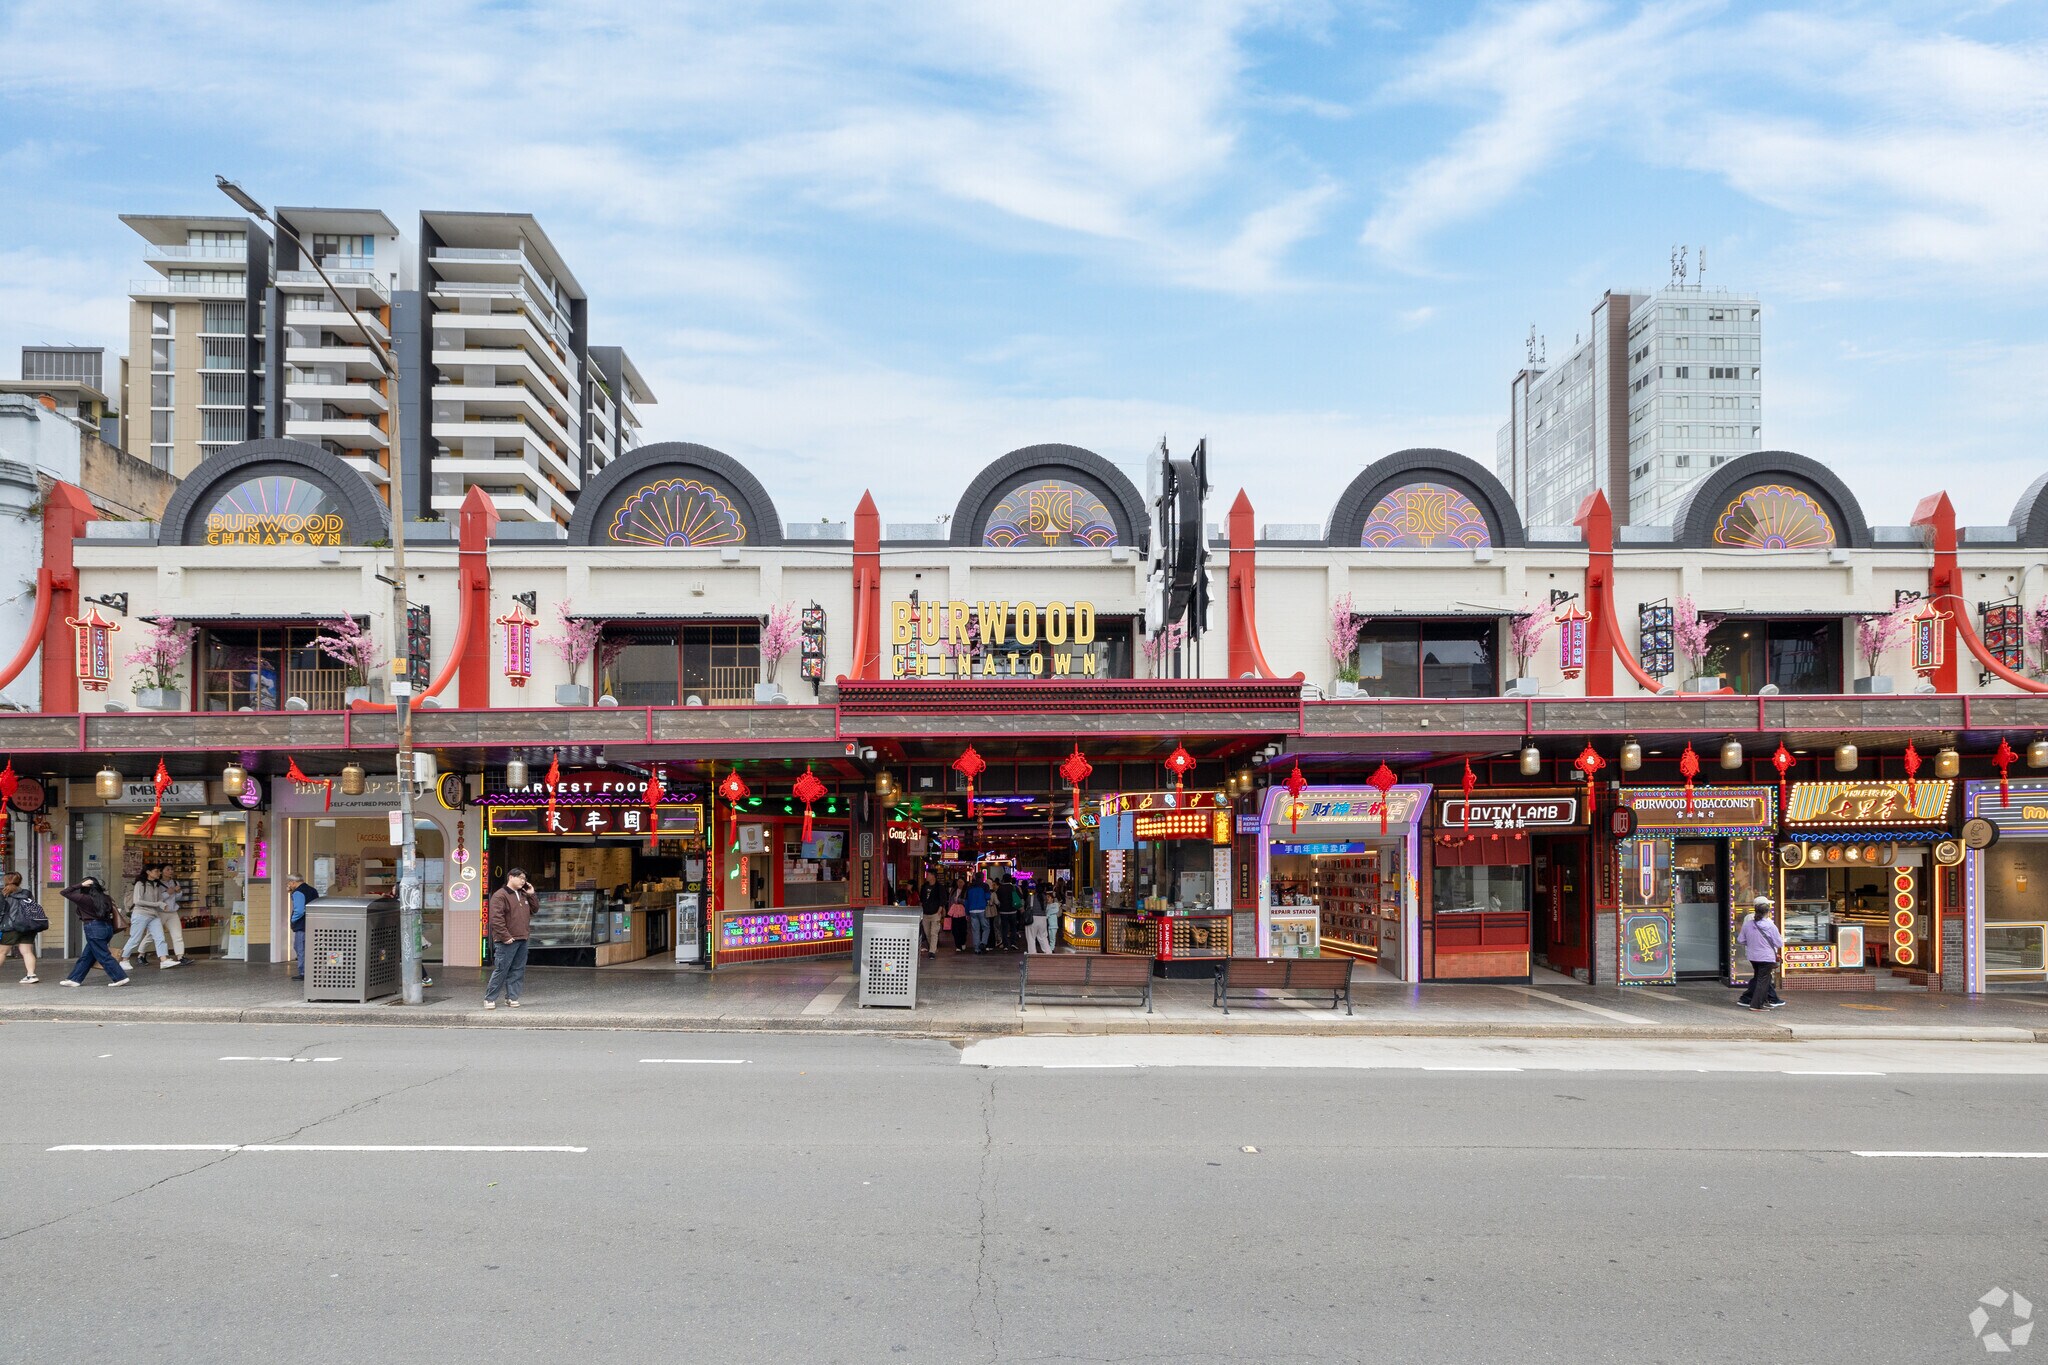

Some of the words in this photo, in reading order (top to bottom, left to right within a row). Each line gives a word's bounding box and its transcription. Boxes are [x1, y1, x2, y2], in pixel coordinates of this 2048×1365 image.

[207, 513, 344, 533] BURWOOD
[207, 532, 341, 546] CHINATOWN
[892, 600, 1095, 645] BURWOOD
[1922, 626, 1930, 660] BURWOOD
[97, 630, 105, 676] CHINATOWN
[892, 653, 1096, 676] CHINATOWN
[130, 785, 179, 795] IMBAU
[602, 783, 668, 793] FOODE
[1311, 801, 1405, 816] 财神手机店
[1635, 799, 1687, 810] BURWOOD
[1831, 797, 1898, 820] 七里香
[889, 827, 907, 843] Gong
[741, 856, 749, 877] Order
[741, 878, 749, 895] Here
[1699, 885, 1714, 893] OPEN
